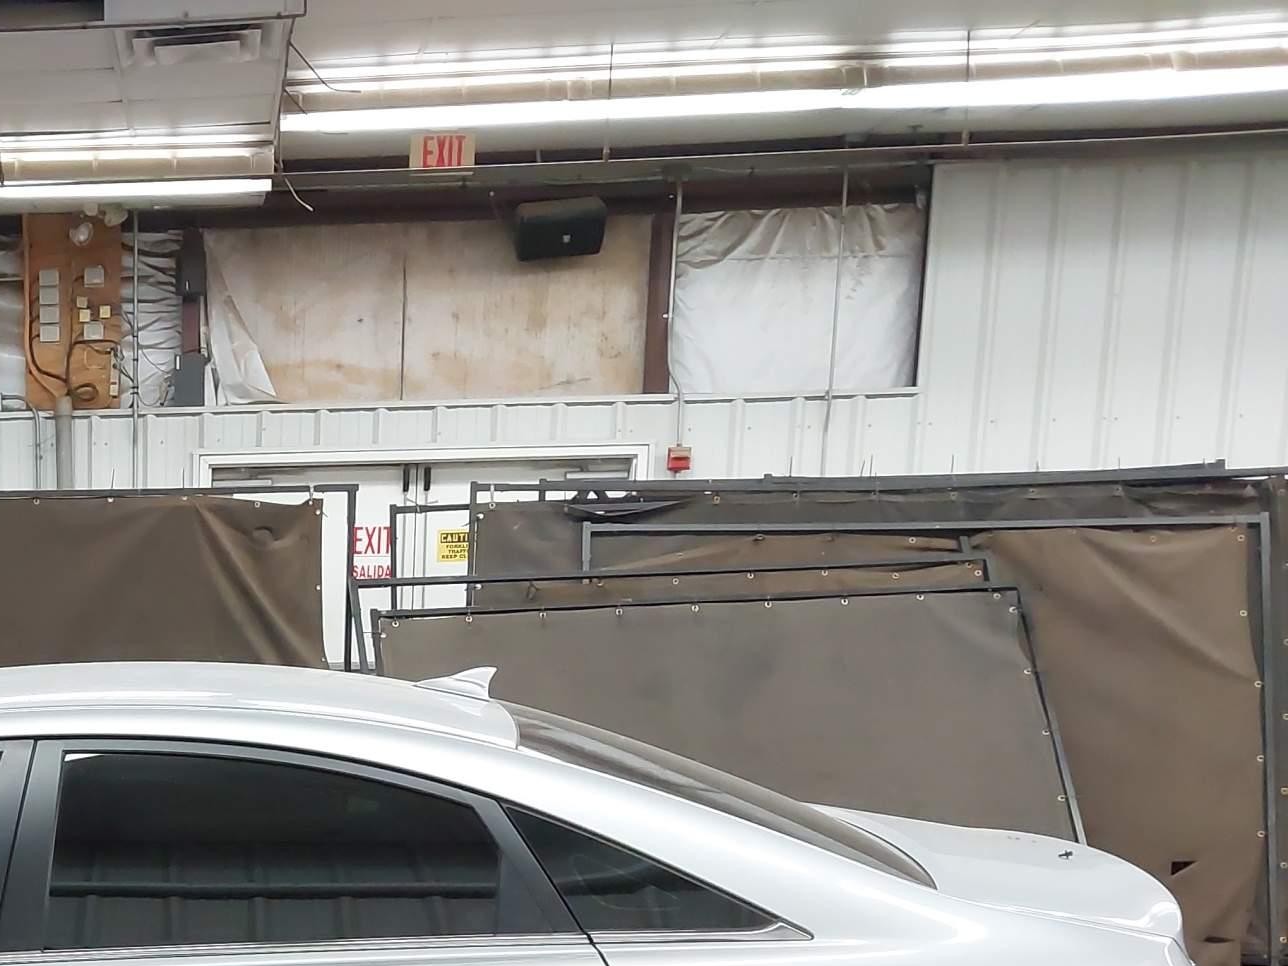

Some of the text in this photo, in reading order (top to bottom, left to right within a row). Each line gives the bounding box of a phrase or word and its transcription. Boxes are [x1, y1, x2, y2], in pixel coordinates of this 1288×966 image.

[423, 135, 466, 168] EXIT
[353, 526, 392, 554] EXIT
[441, 533, 468, 542] CAUTI
[352, 565, 392, 578] SALIDA
